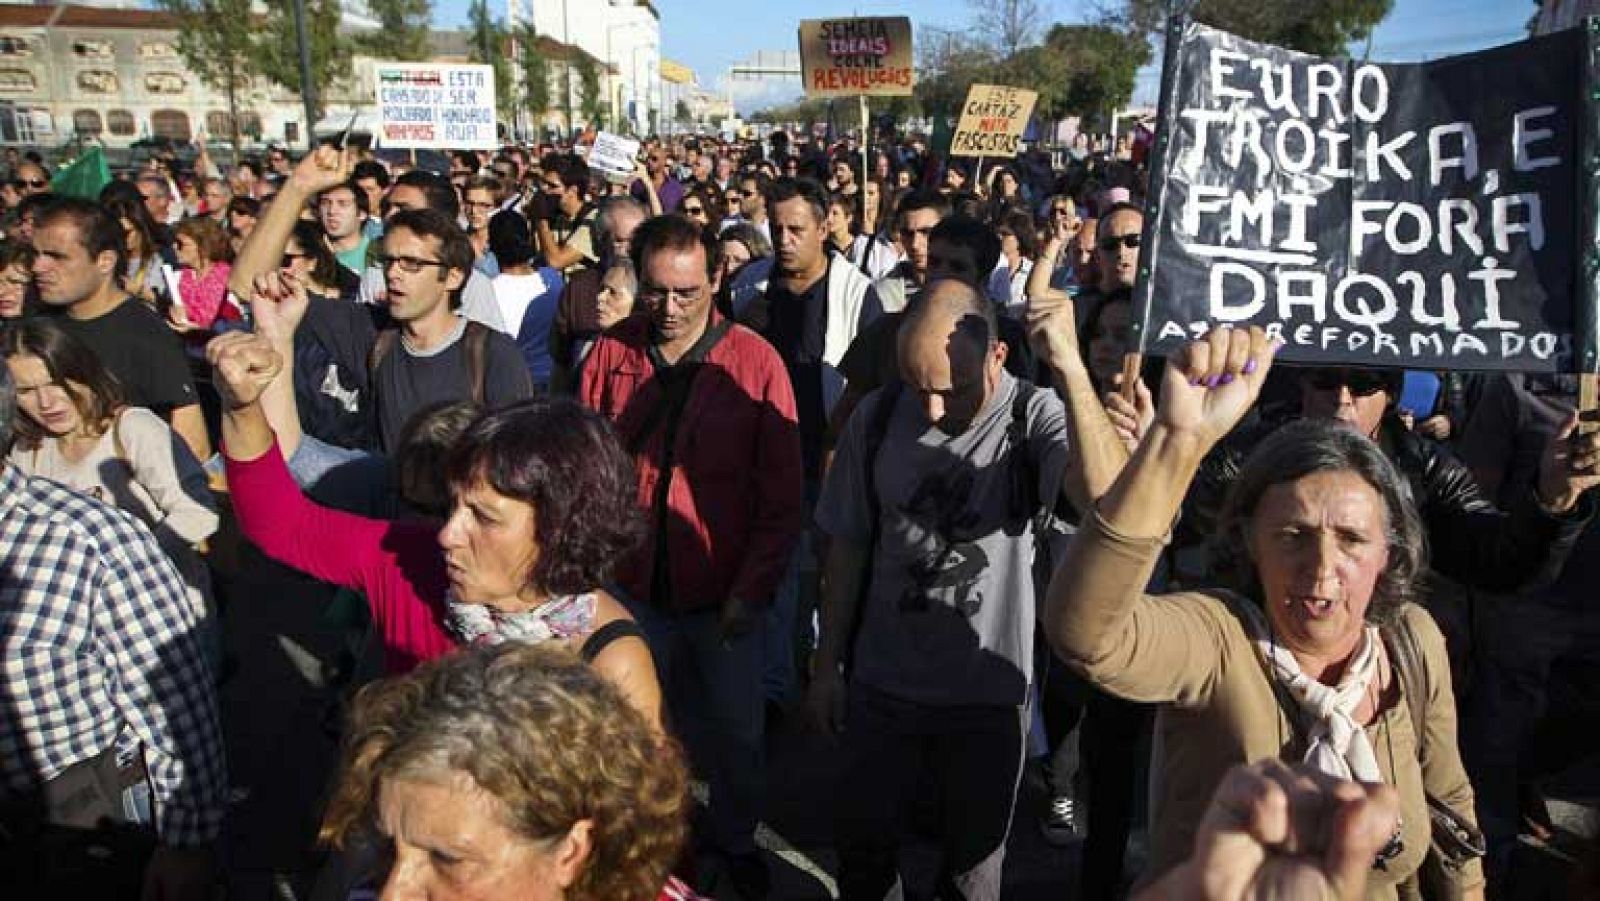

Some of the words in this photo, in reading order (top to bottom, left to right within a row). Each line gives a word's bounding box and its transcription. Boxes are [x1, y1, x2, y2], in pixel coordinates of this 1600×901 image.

[830, 37, 887, 54] IDEAIS
[449, 88, 477, 104] SER
[1210, 49, 1389, 124] EURO
[1513, 106, 1561, 172] E
[1182, 179, 1318, 253] FMI
[1352, 192, 1545, 257] FORA
[1209, 258, 1520, 332] DAQUI
[1265, 322, 1574, 358] REFORMADOS
